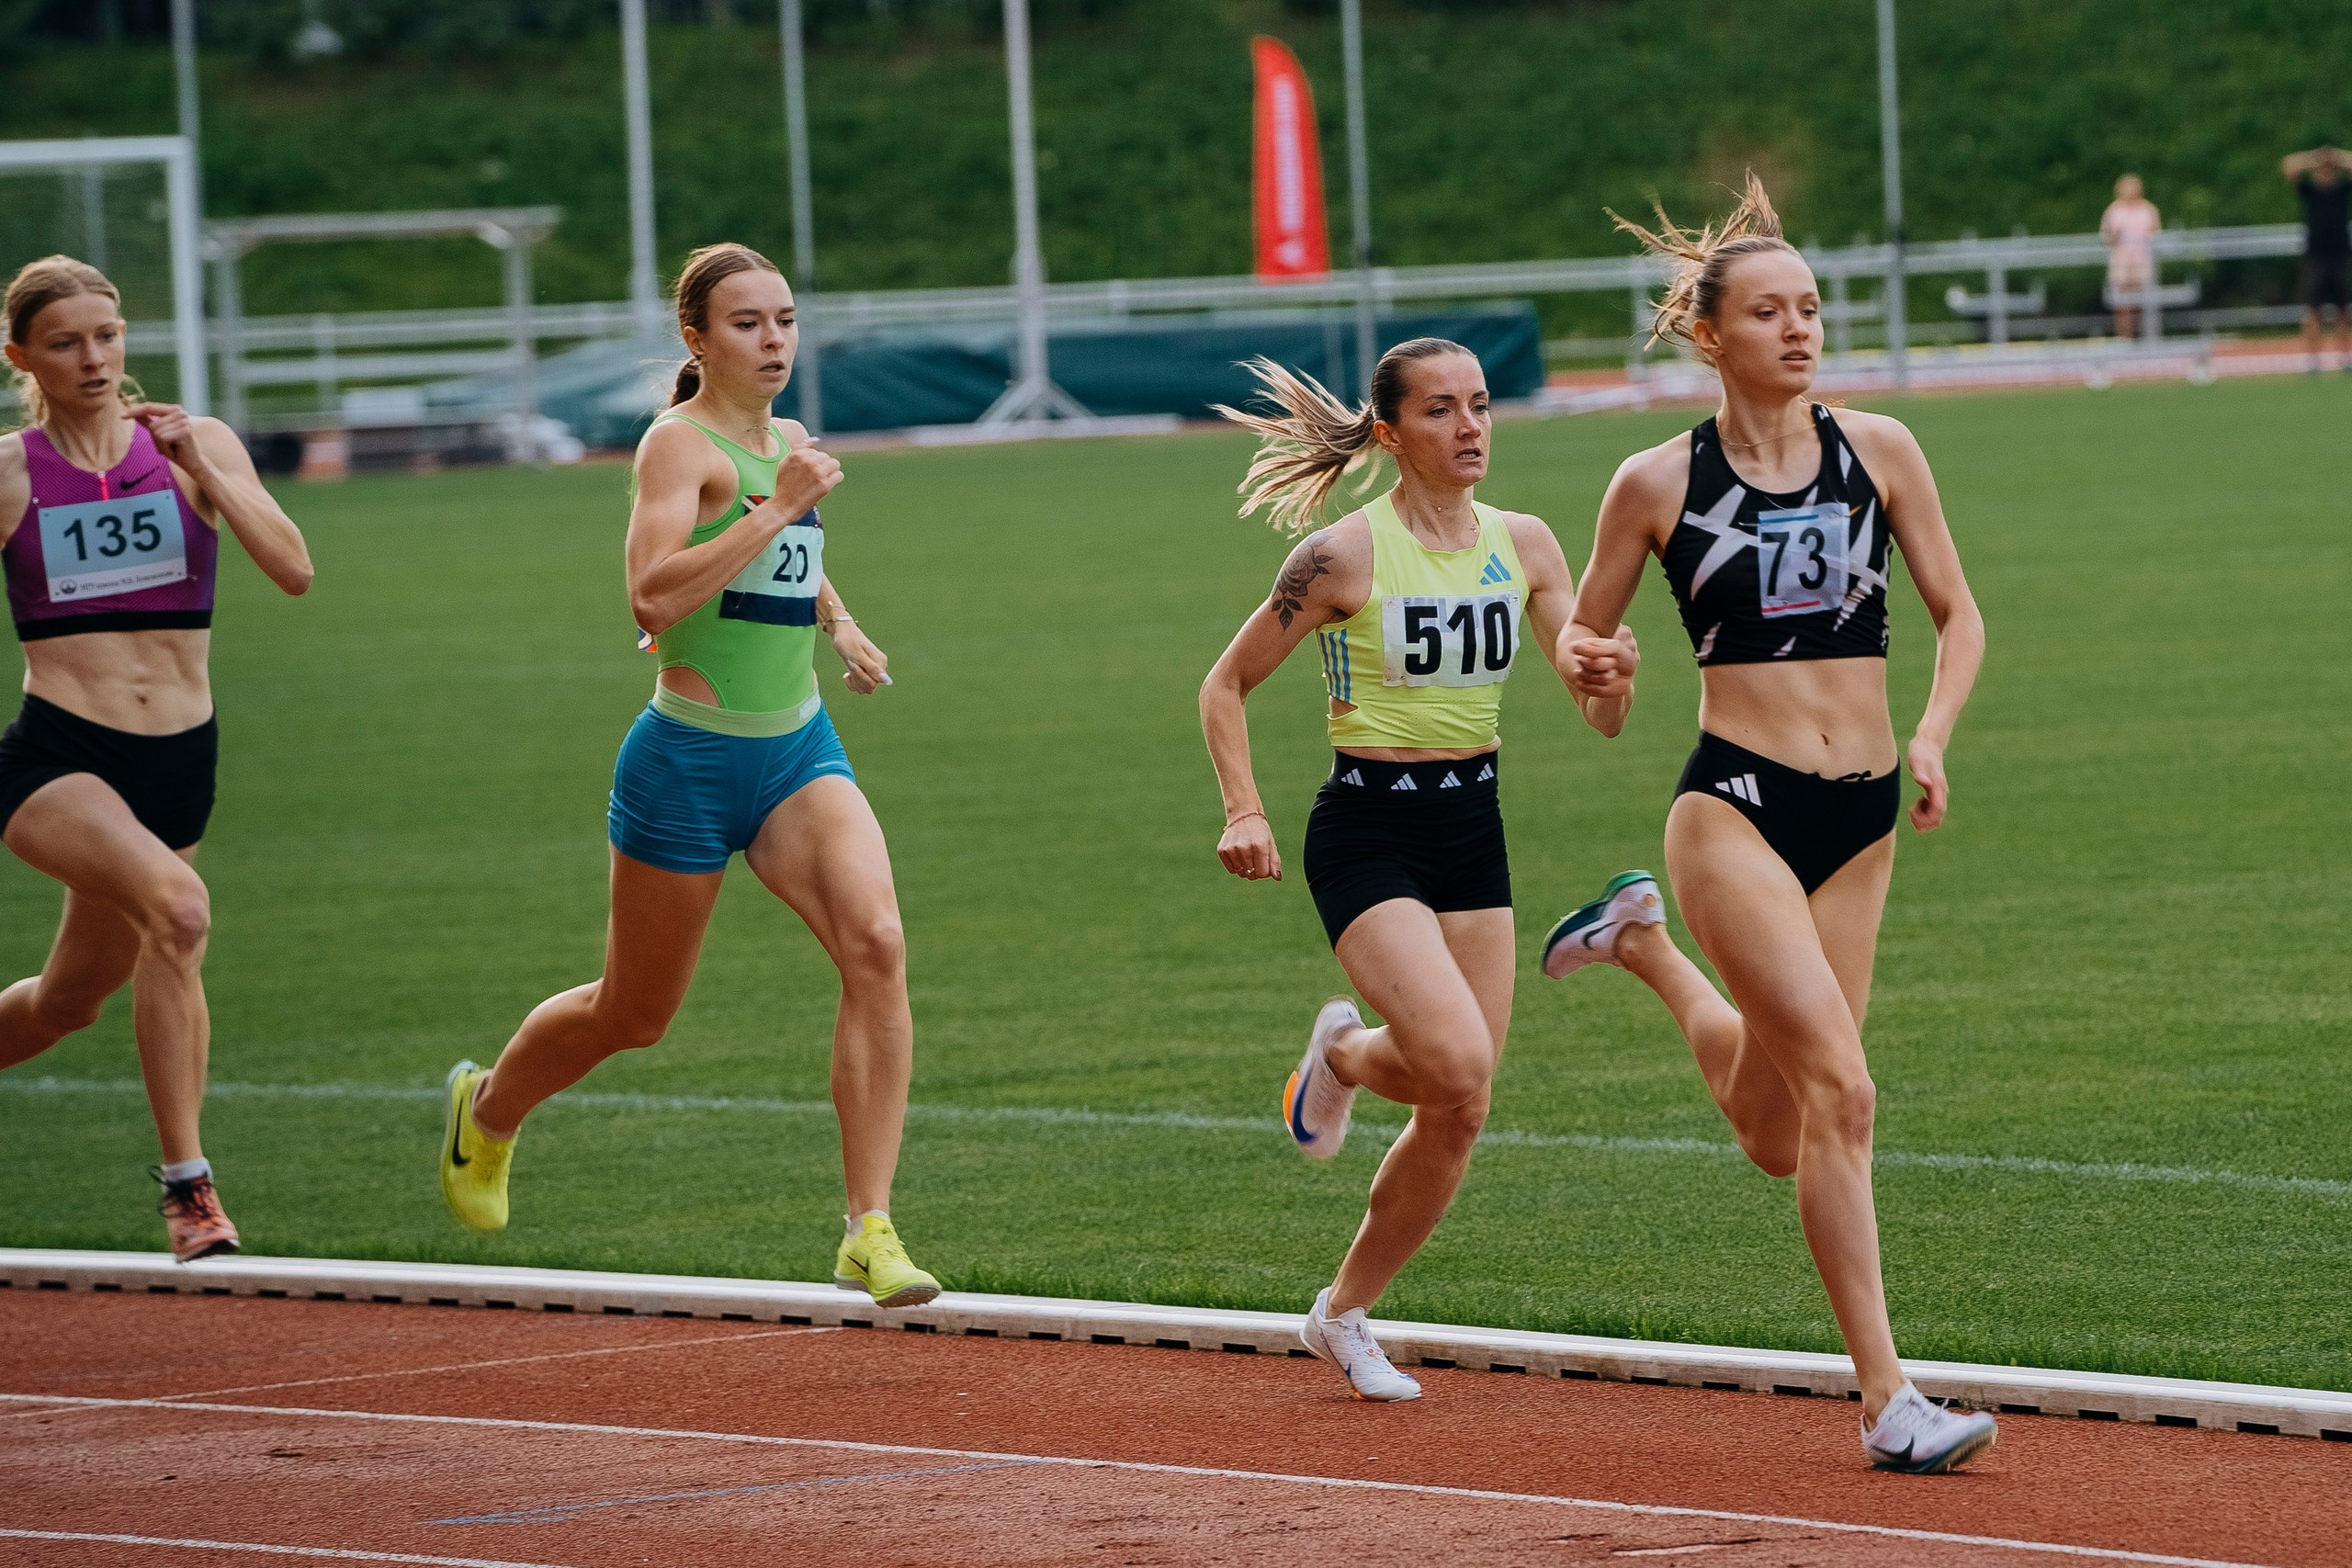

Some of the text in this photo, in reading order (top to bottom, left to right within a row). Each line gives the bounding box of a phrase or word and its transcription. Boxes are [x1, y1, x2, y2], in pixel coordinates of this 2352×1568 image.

[63, 508, 162, 561] 135
[772, 542, 808, 584] 20
[1761, 526, 1828, 597] 73
[1404, 601, 1512, 675] 510
